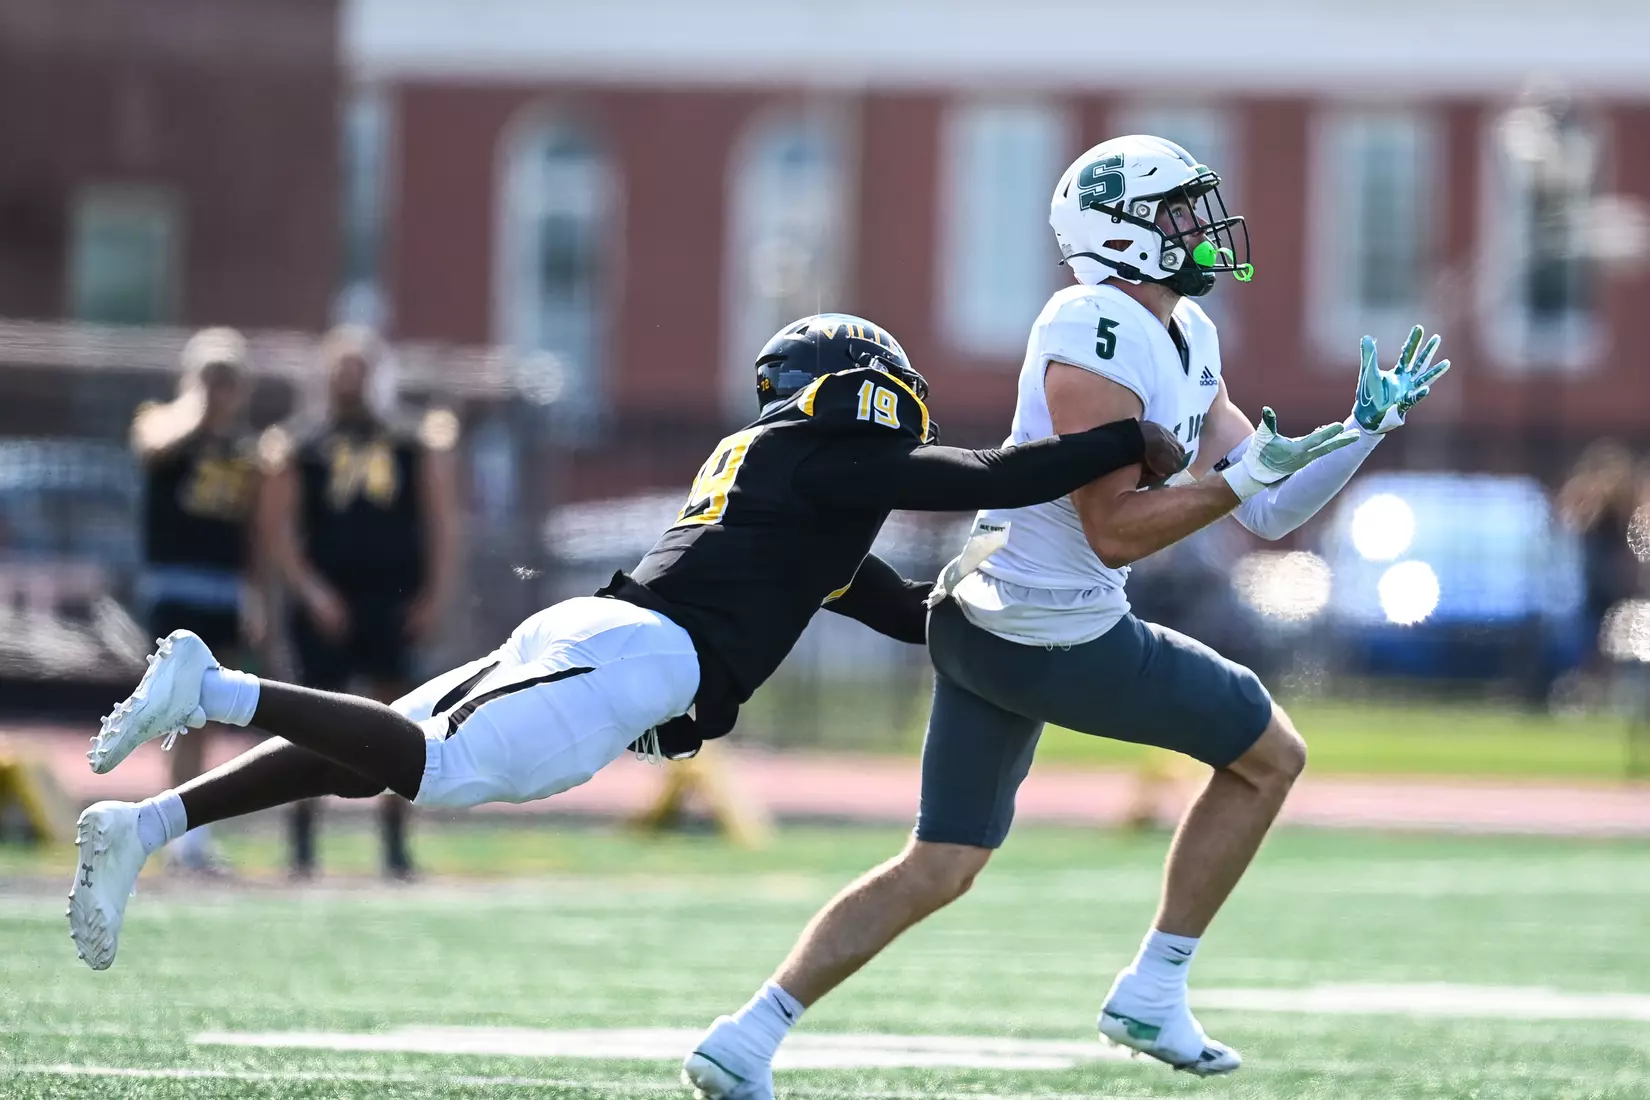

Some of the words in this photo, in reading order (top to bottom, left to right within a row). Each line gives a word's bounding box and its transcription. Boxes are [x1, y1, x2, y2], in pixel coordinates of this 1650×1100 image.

[1077, 152, 1126, 211] S
[1095, 317, 1120, 360] 5
[856, 379, 900, 430] 19
